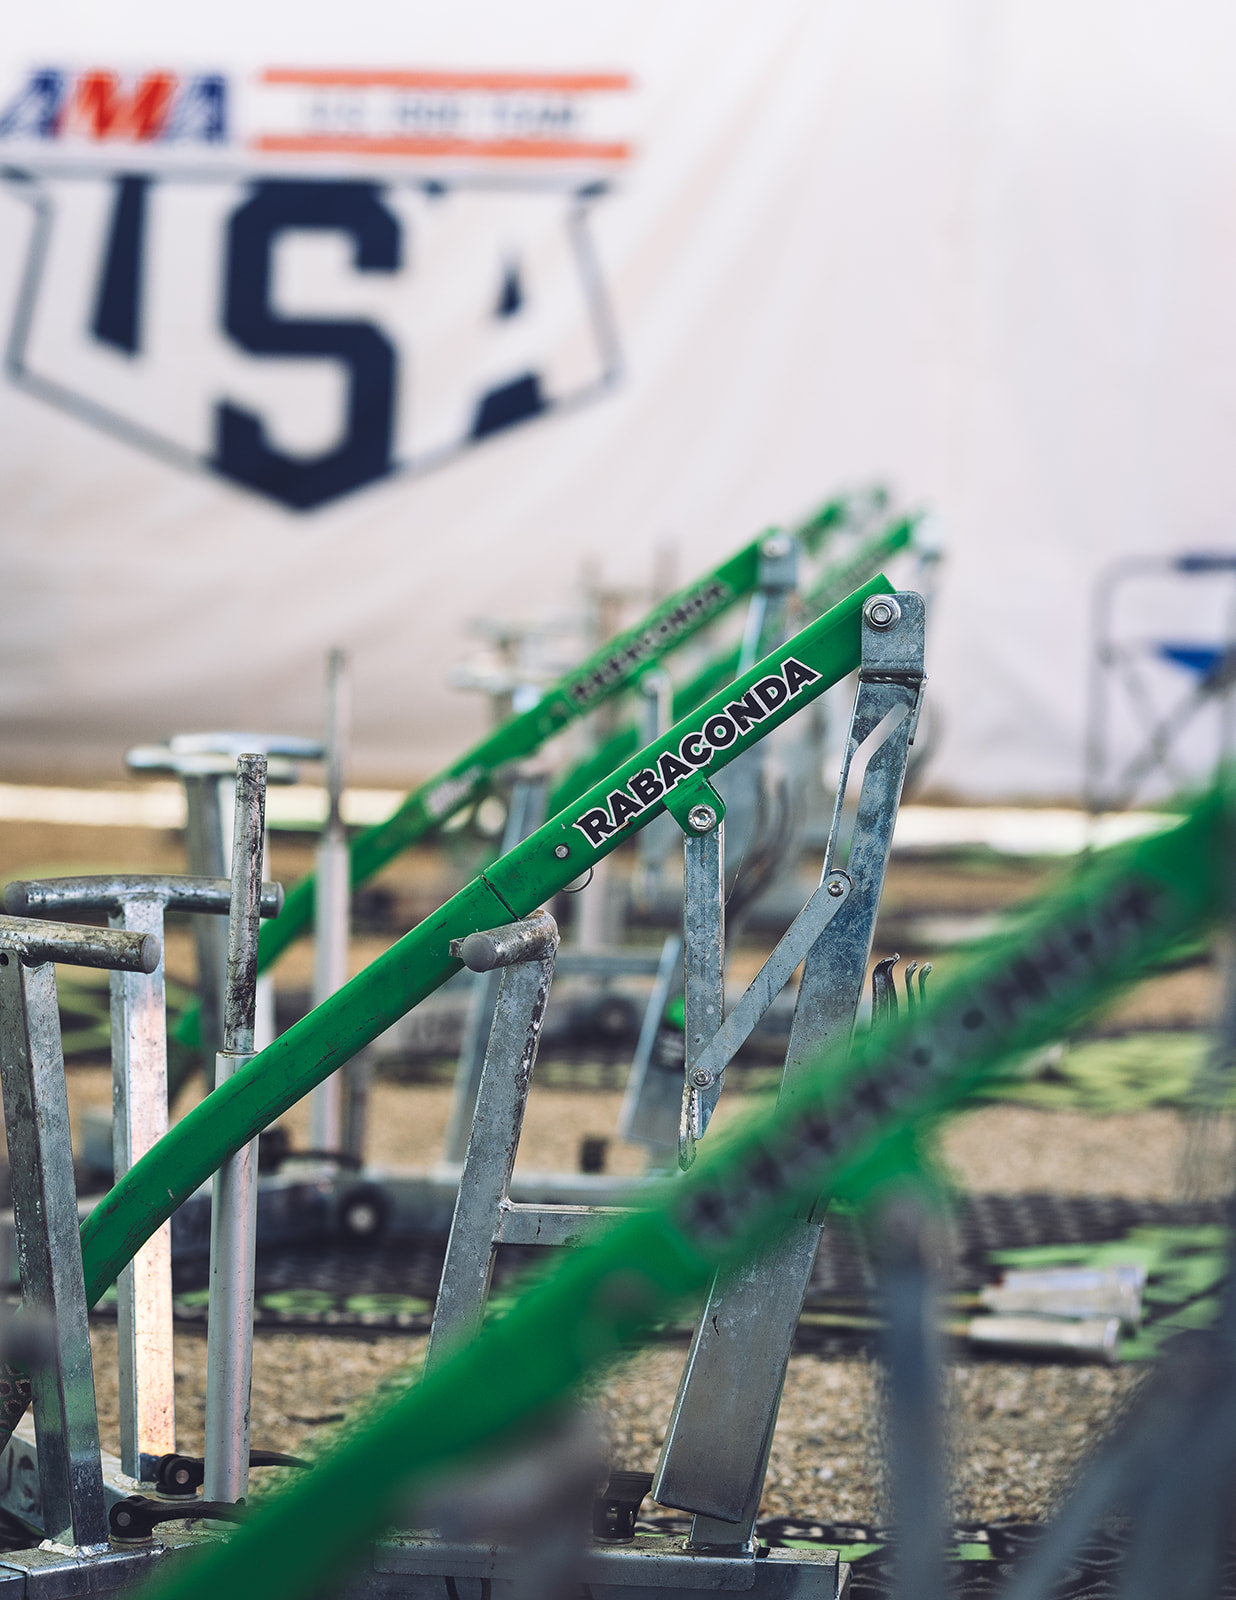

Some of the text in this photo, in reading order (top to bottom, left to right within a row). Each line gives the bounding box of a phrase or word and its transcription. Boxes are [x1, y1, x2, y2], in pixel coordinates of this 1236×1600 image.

[0, 69, 227, 143] AMA
[14, 174, 616, 511] USA
[573, 657, 822, 848] RABACONDA
